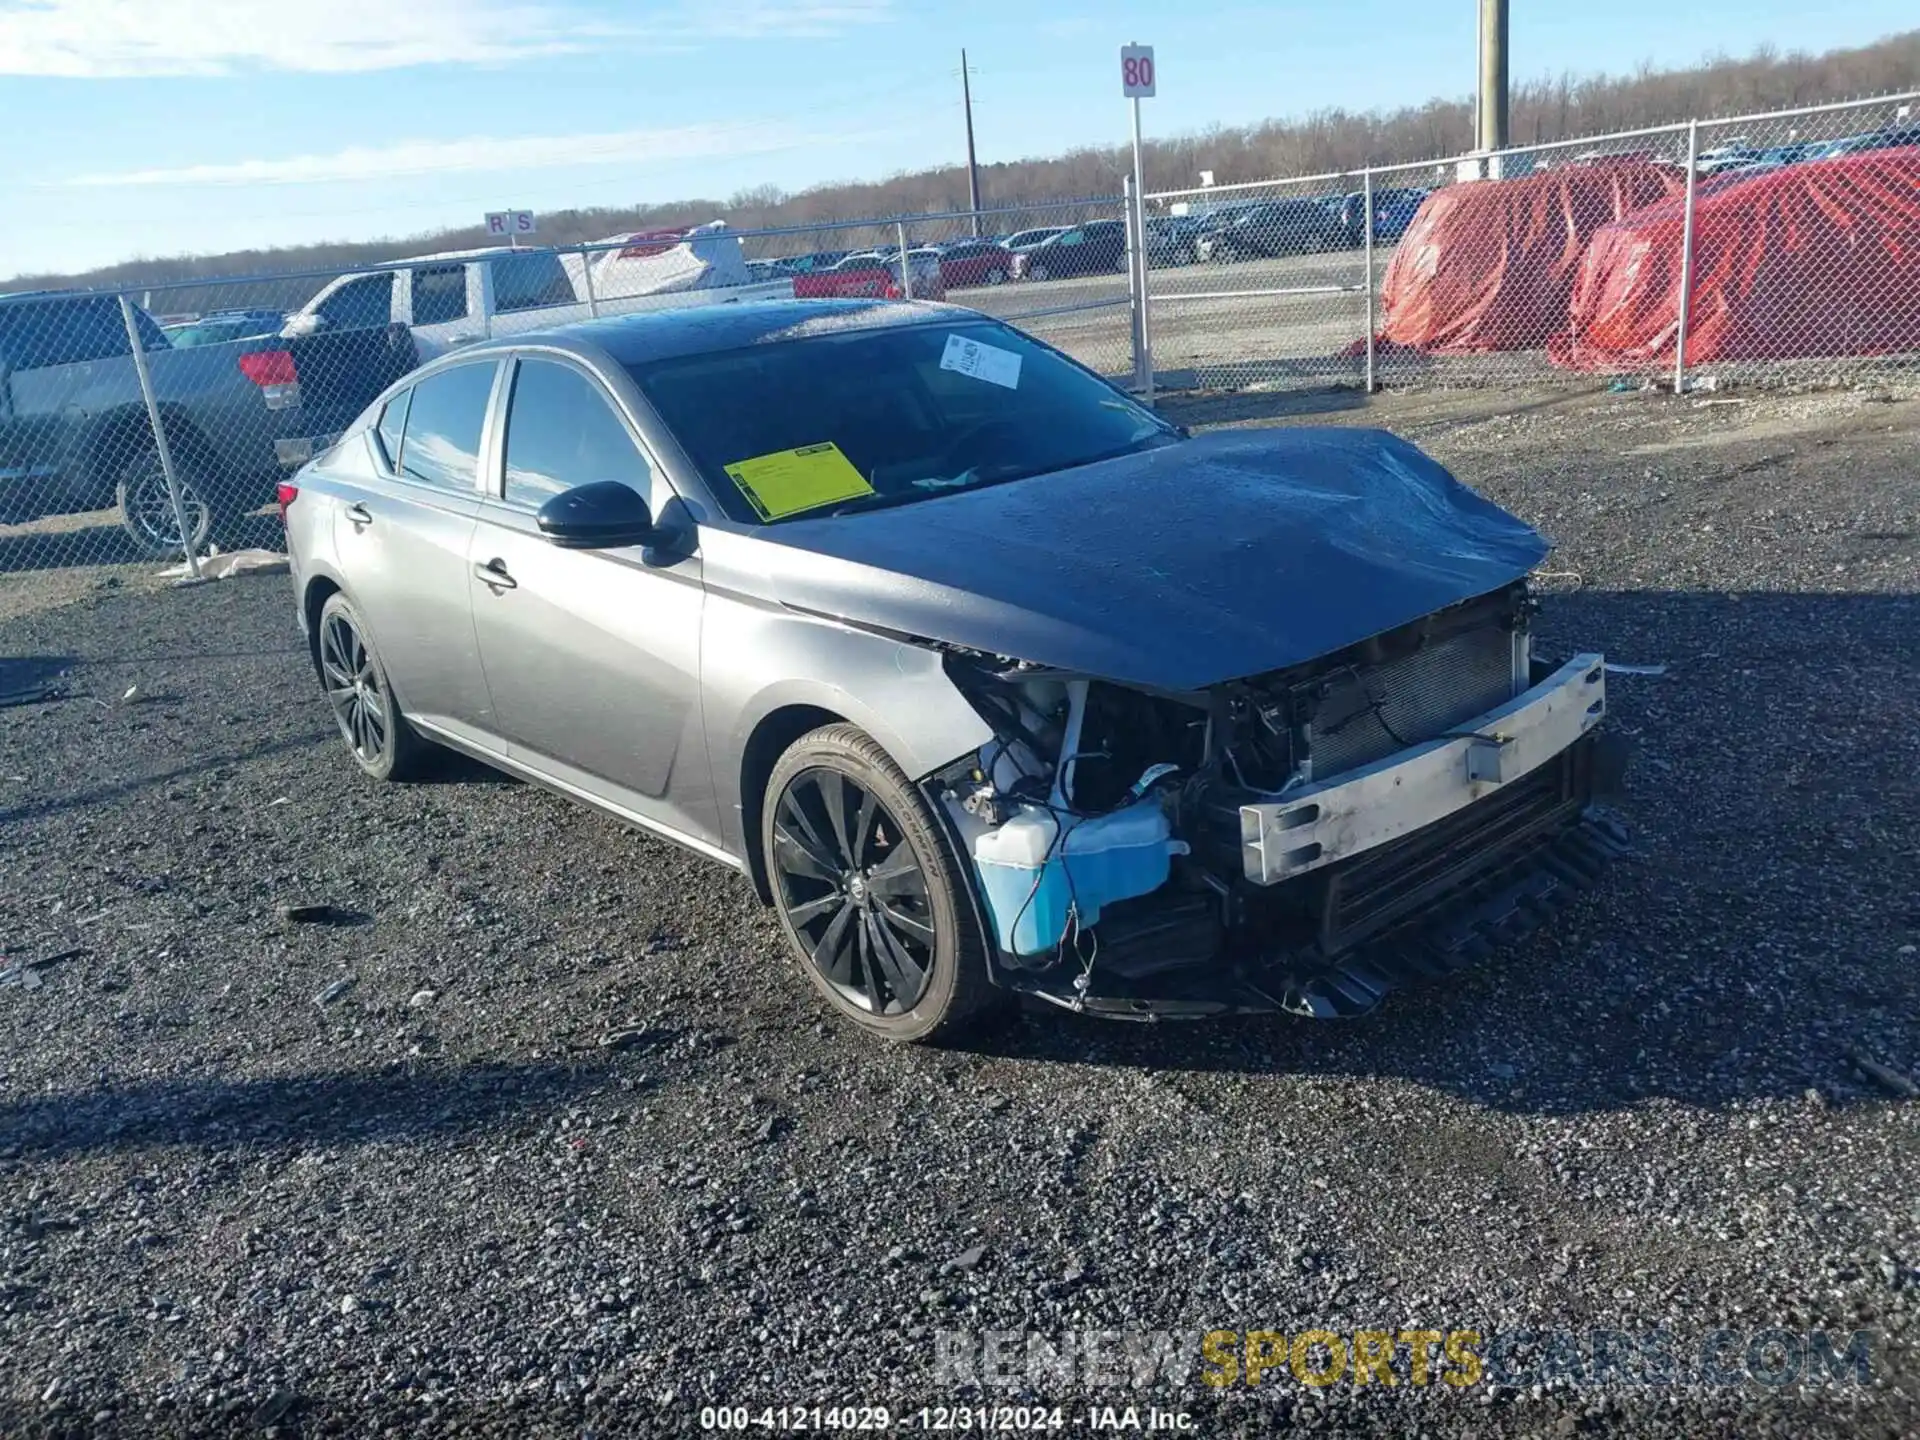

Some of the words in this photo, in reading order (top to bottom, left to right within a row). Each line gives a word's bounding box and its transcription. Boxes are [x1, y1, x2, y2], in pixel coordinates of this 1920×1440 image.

[1124, 56, 1153, 87] 80
[489, 215, 504, 233] R
[518, 214, 531, 231] S
